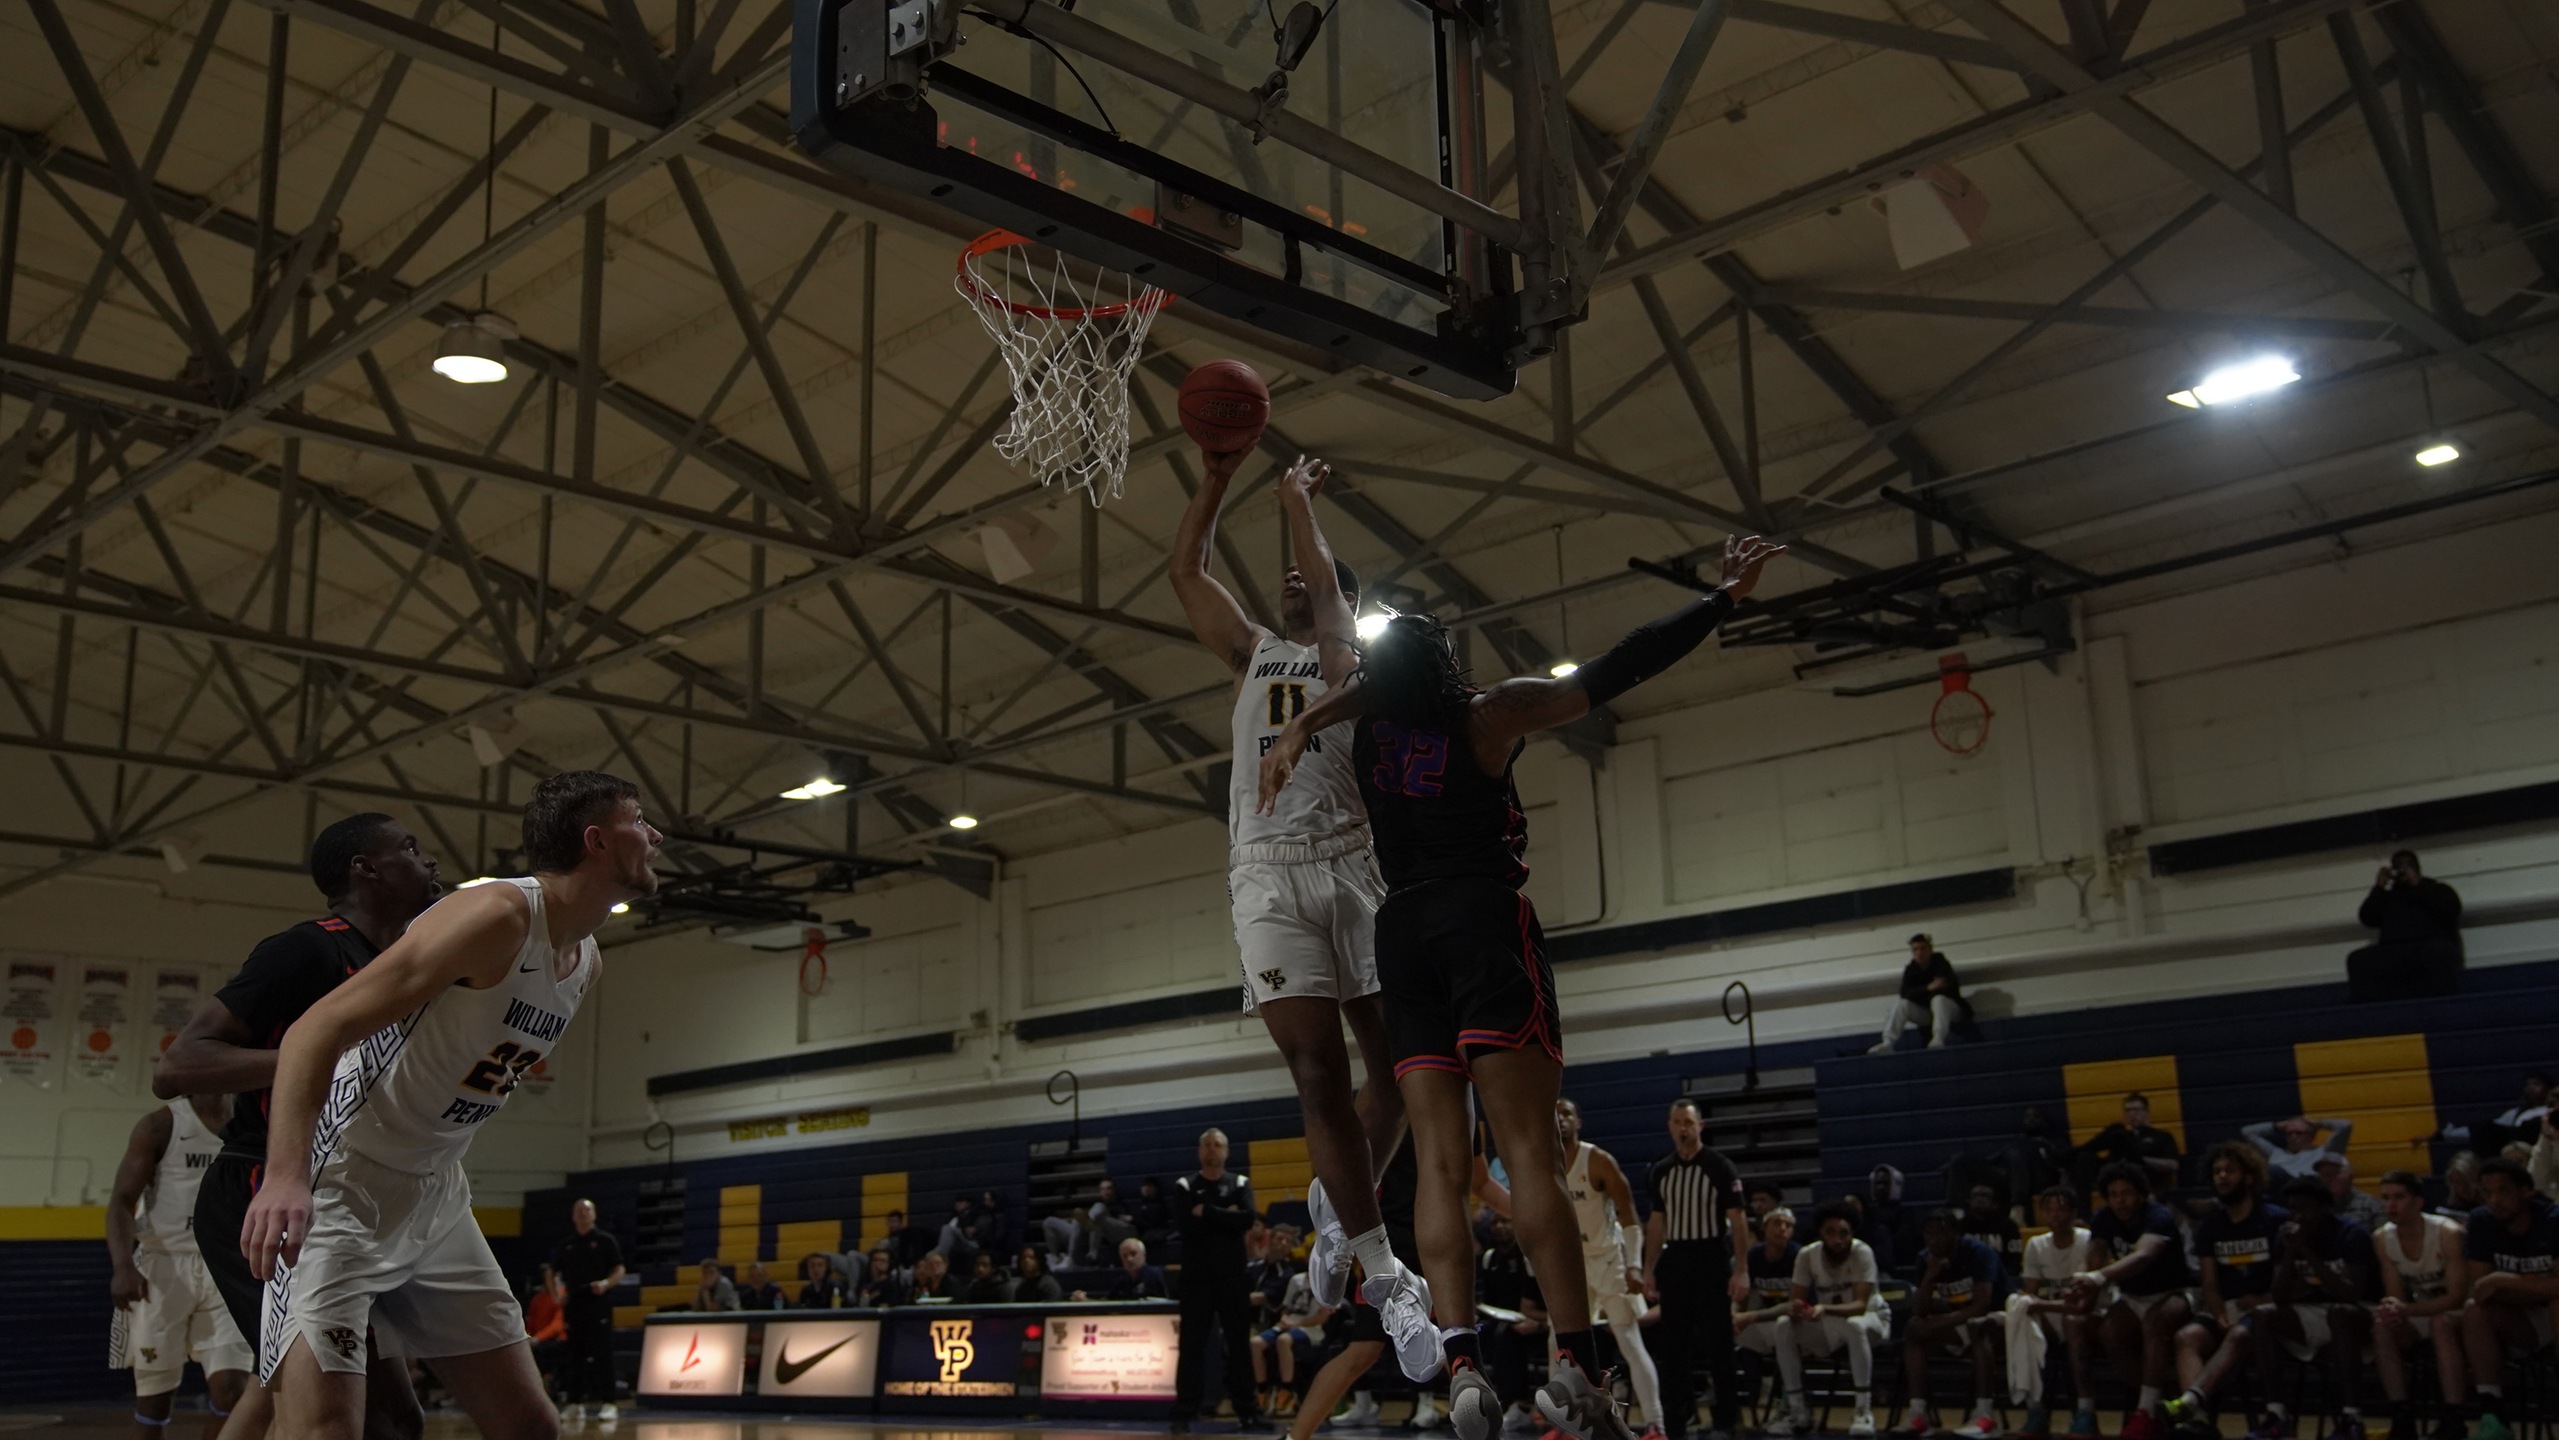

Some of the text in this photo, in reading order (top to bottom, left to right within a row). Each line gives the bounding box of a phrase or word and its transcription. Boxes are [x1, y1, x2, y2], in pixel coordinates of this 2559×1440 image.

[1254, 662, 1324, 680] WILLIA
[1268, 681, 1308, 727] 11
[1258, 734, 1322, 757] PN
[1372, 719, 1449, 797] 32
[502, 997, 567, 1043] WILLIAM
[930, 1320, 974, 1382] WP
